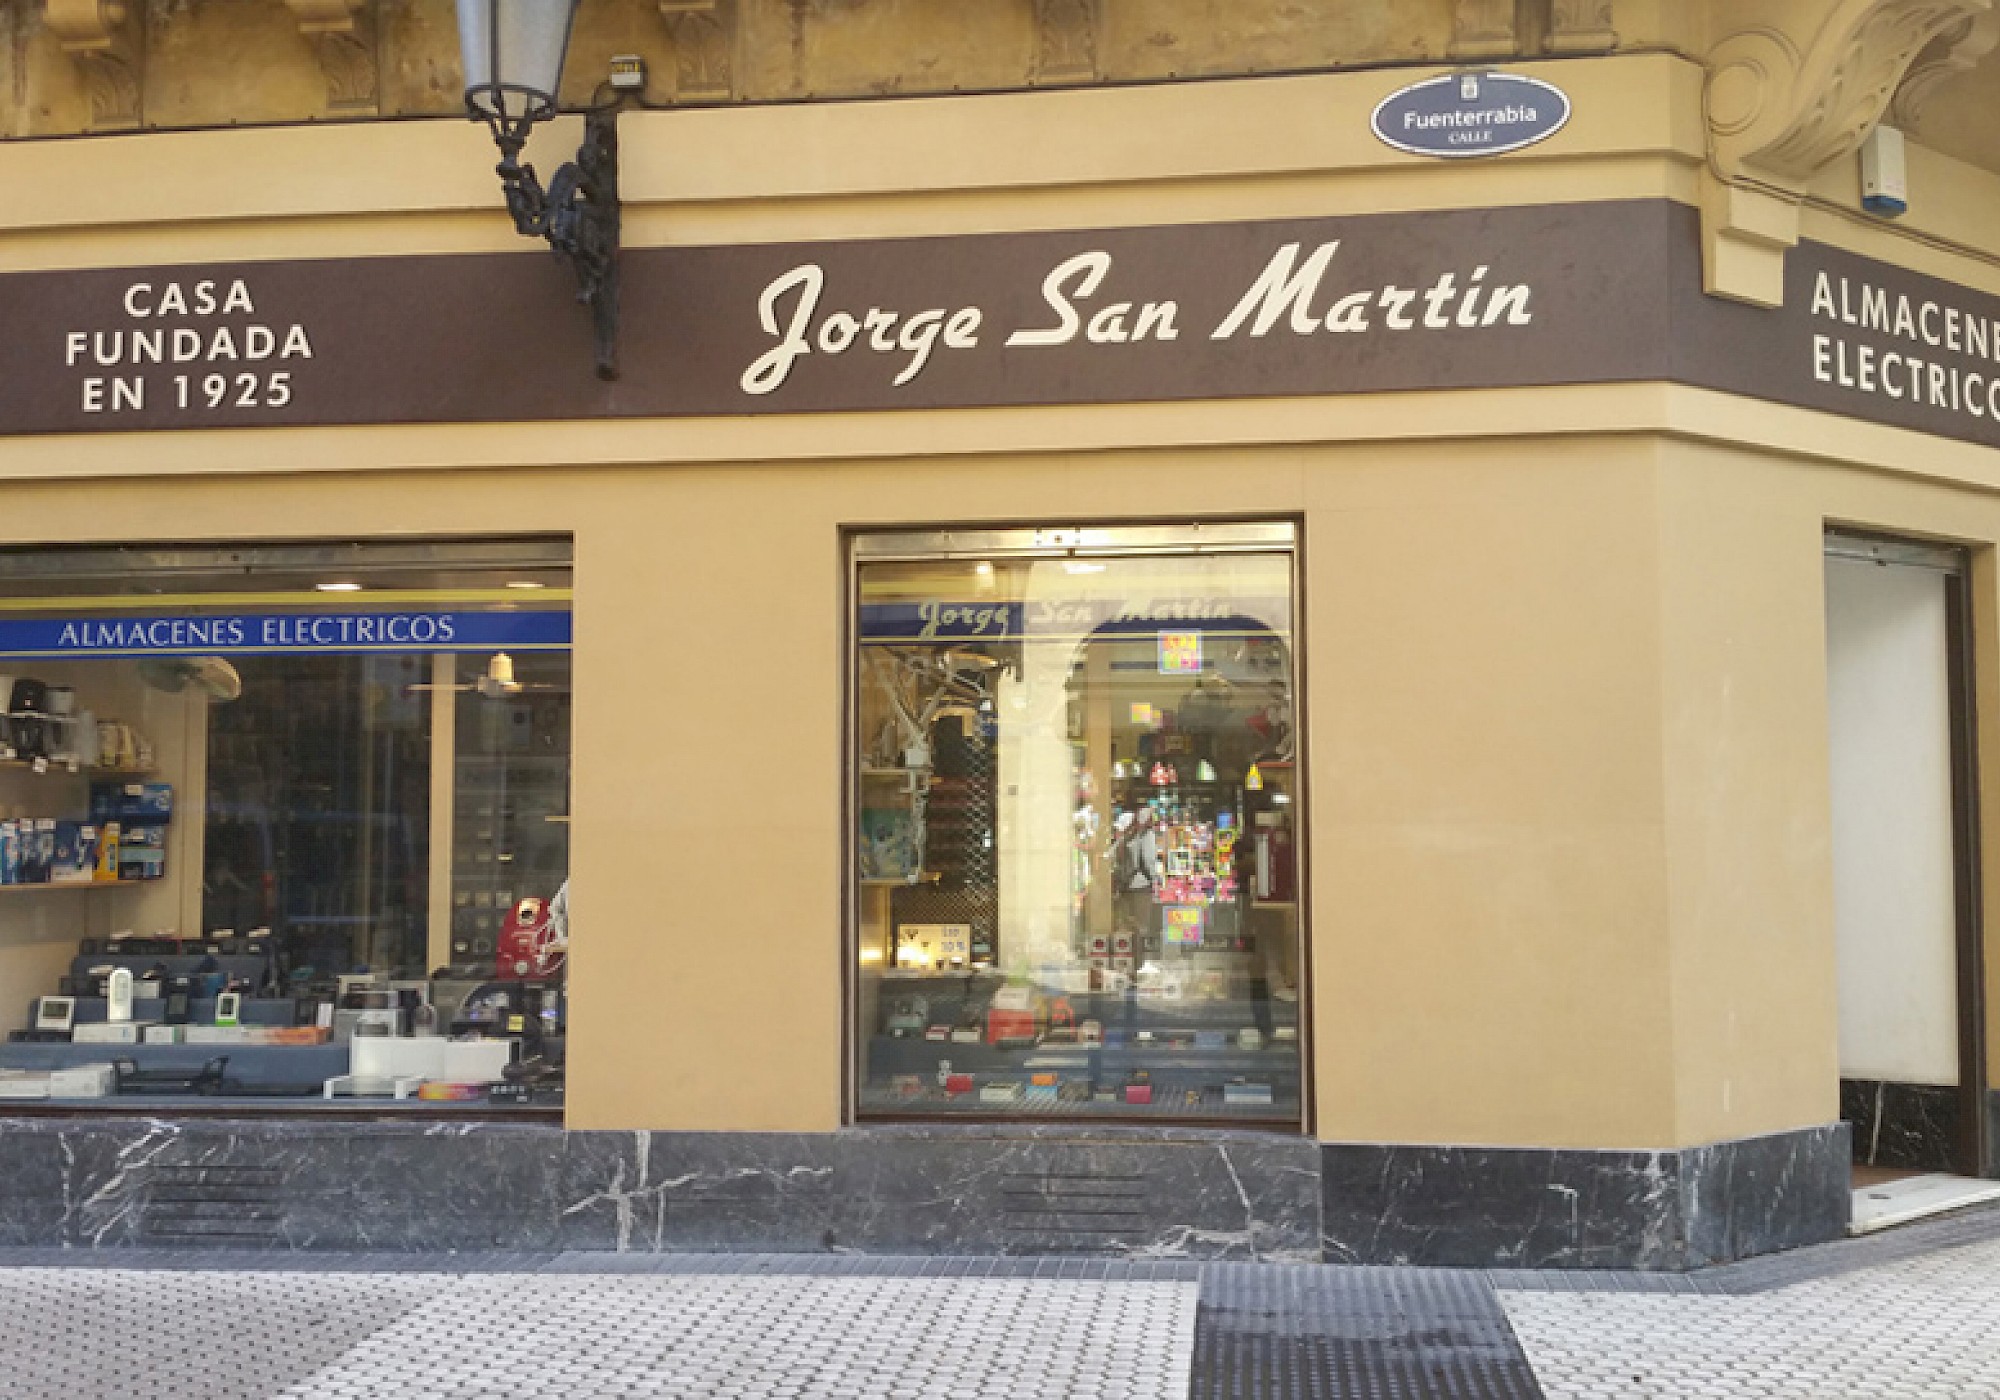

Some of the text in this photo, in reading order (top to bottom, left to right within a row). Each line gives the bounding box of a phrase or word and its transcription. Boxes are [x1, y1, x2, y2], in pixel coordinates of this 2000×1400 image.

[1448, 130, 1493, 145] CALLE
[123, 278, 255, 318] CASA
[740, 239, 1532, 395] Jorge San Martin
[64, 323, 314, 367] FUNDADA
[81, 370, 292, 412] EN 1925
[57, 613, 456, 648] ALMACENES ELECTRICOS
